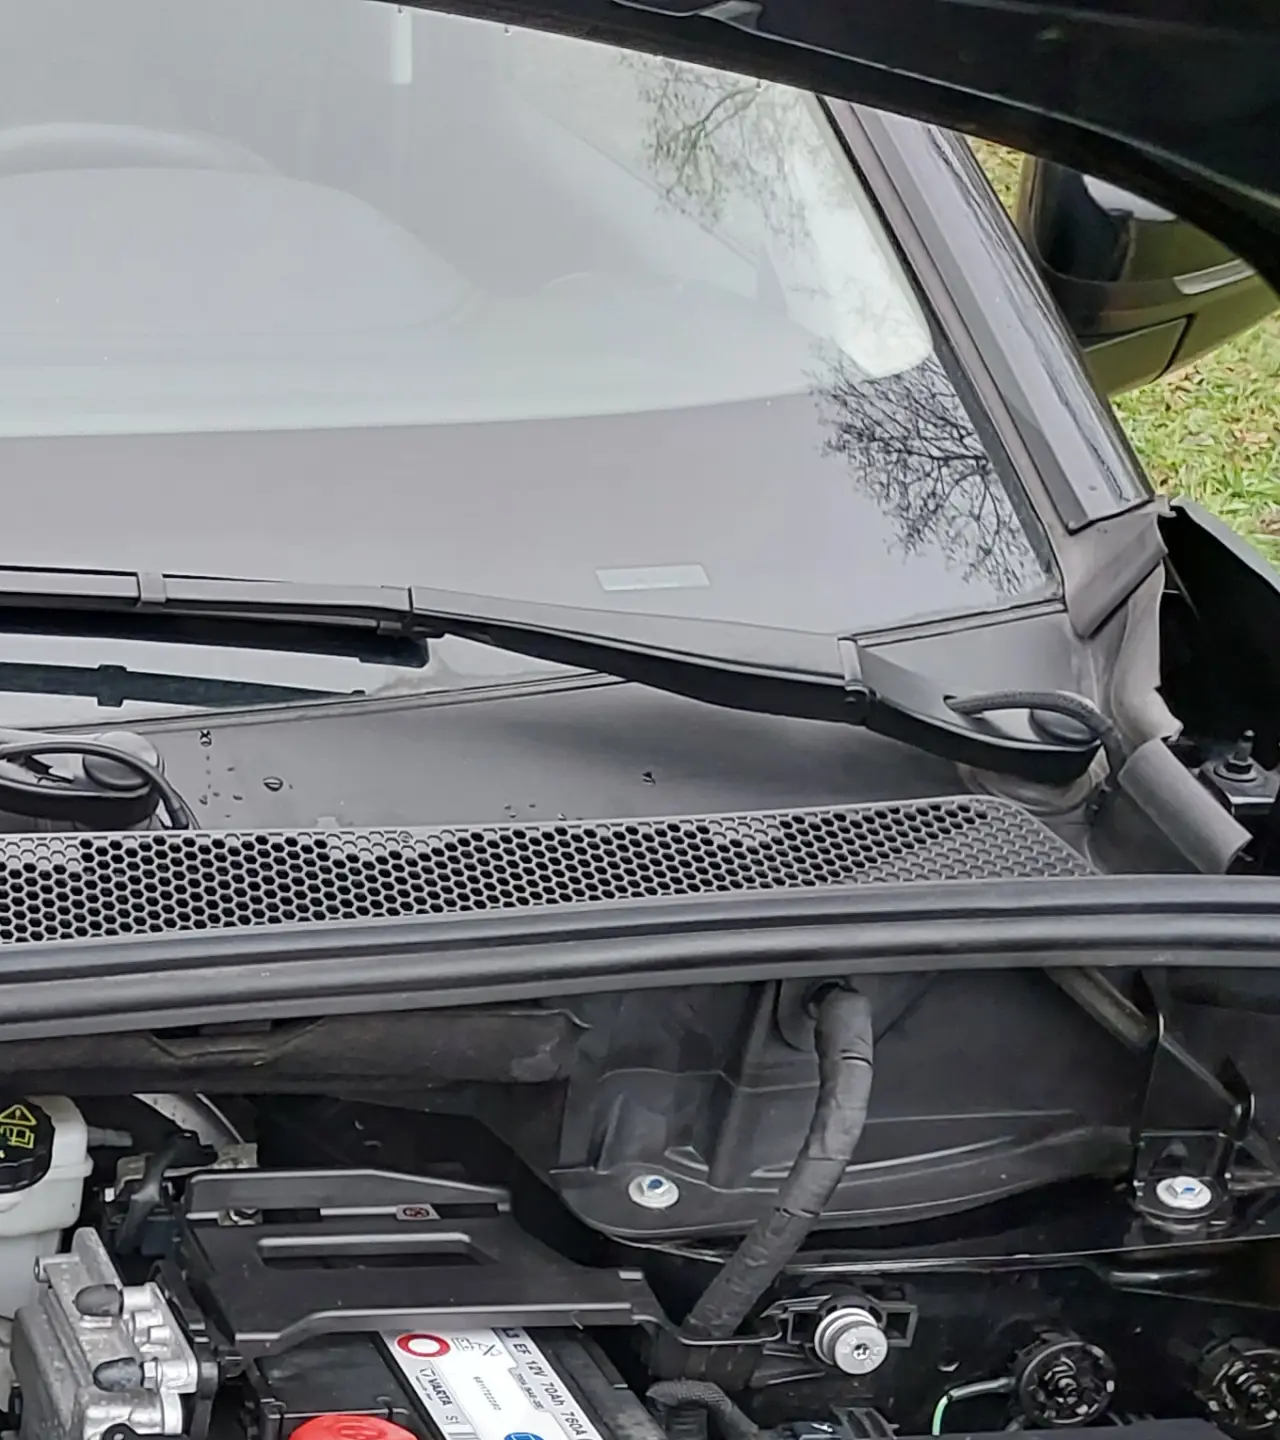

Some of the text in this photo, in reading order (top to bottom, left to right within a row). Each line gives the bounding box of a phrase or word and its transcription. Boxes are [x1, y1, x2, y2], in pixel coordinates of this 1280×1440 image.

[428, 1377, 453, 1407] VARTA
[525, 1360, 549, 1378] 12V
[540, 1381, 567, 1407] 70Ah
[560, 1411, 589, 1436] 760A
